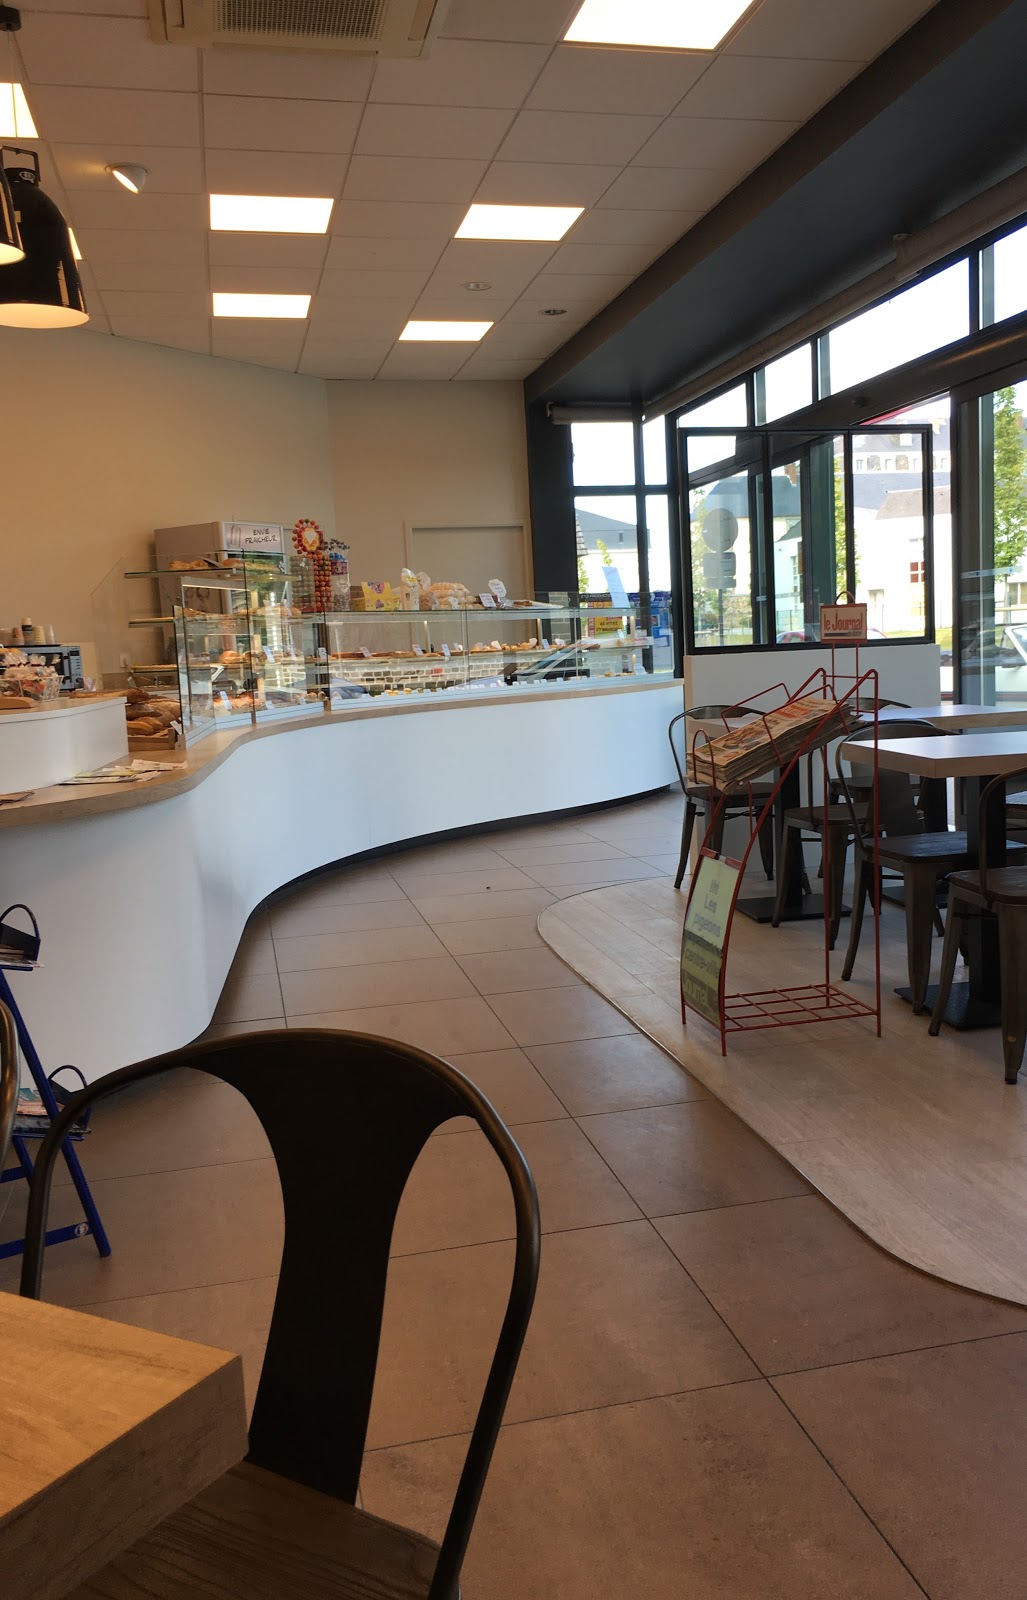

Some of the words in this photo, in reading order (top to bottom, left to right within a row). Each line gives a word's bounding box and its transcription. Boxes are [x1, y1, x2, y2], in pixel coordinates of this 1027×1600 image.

[824, 614, 831, 631] le
[832, 609, 863, 631] Journal
[704, 893, 717, 913] Les
